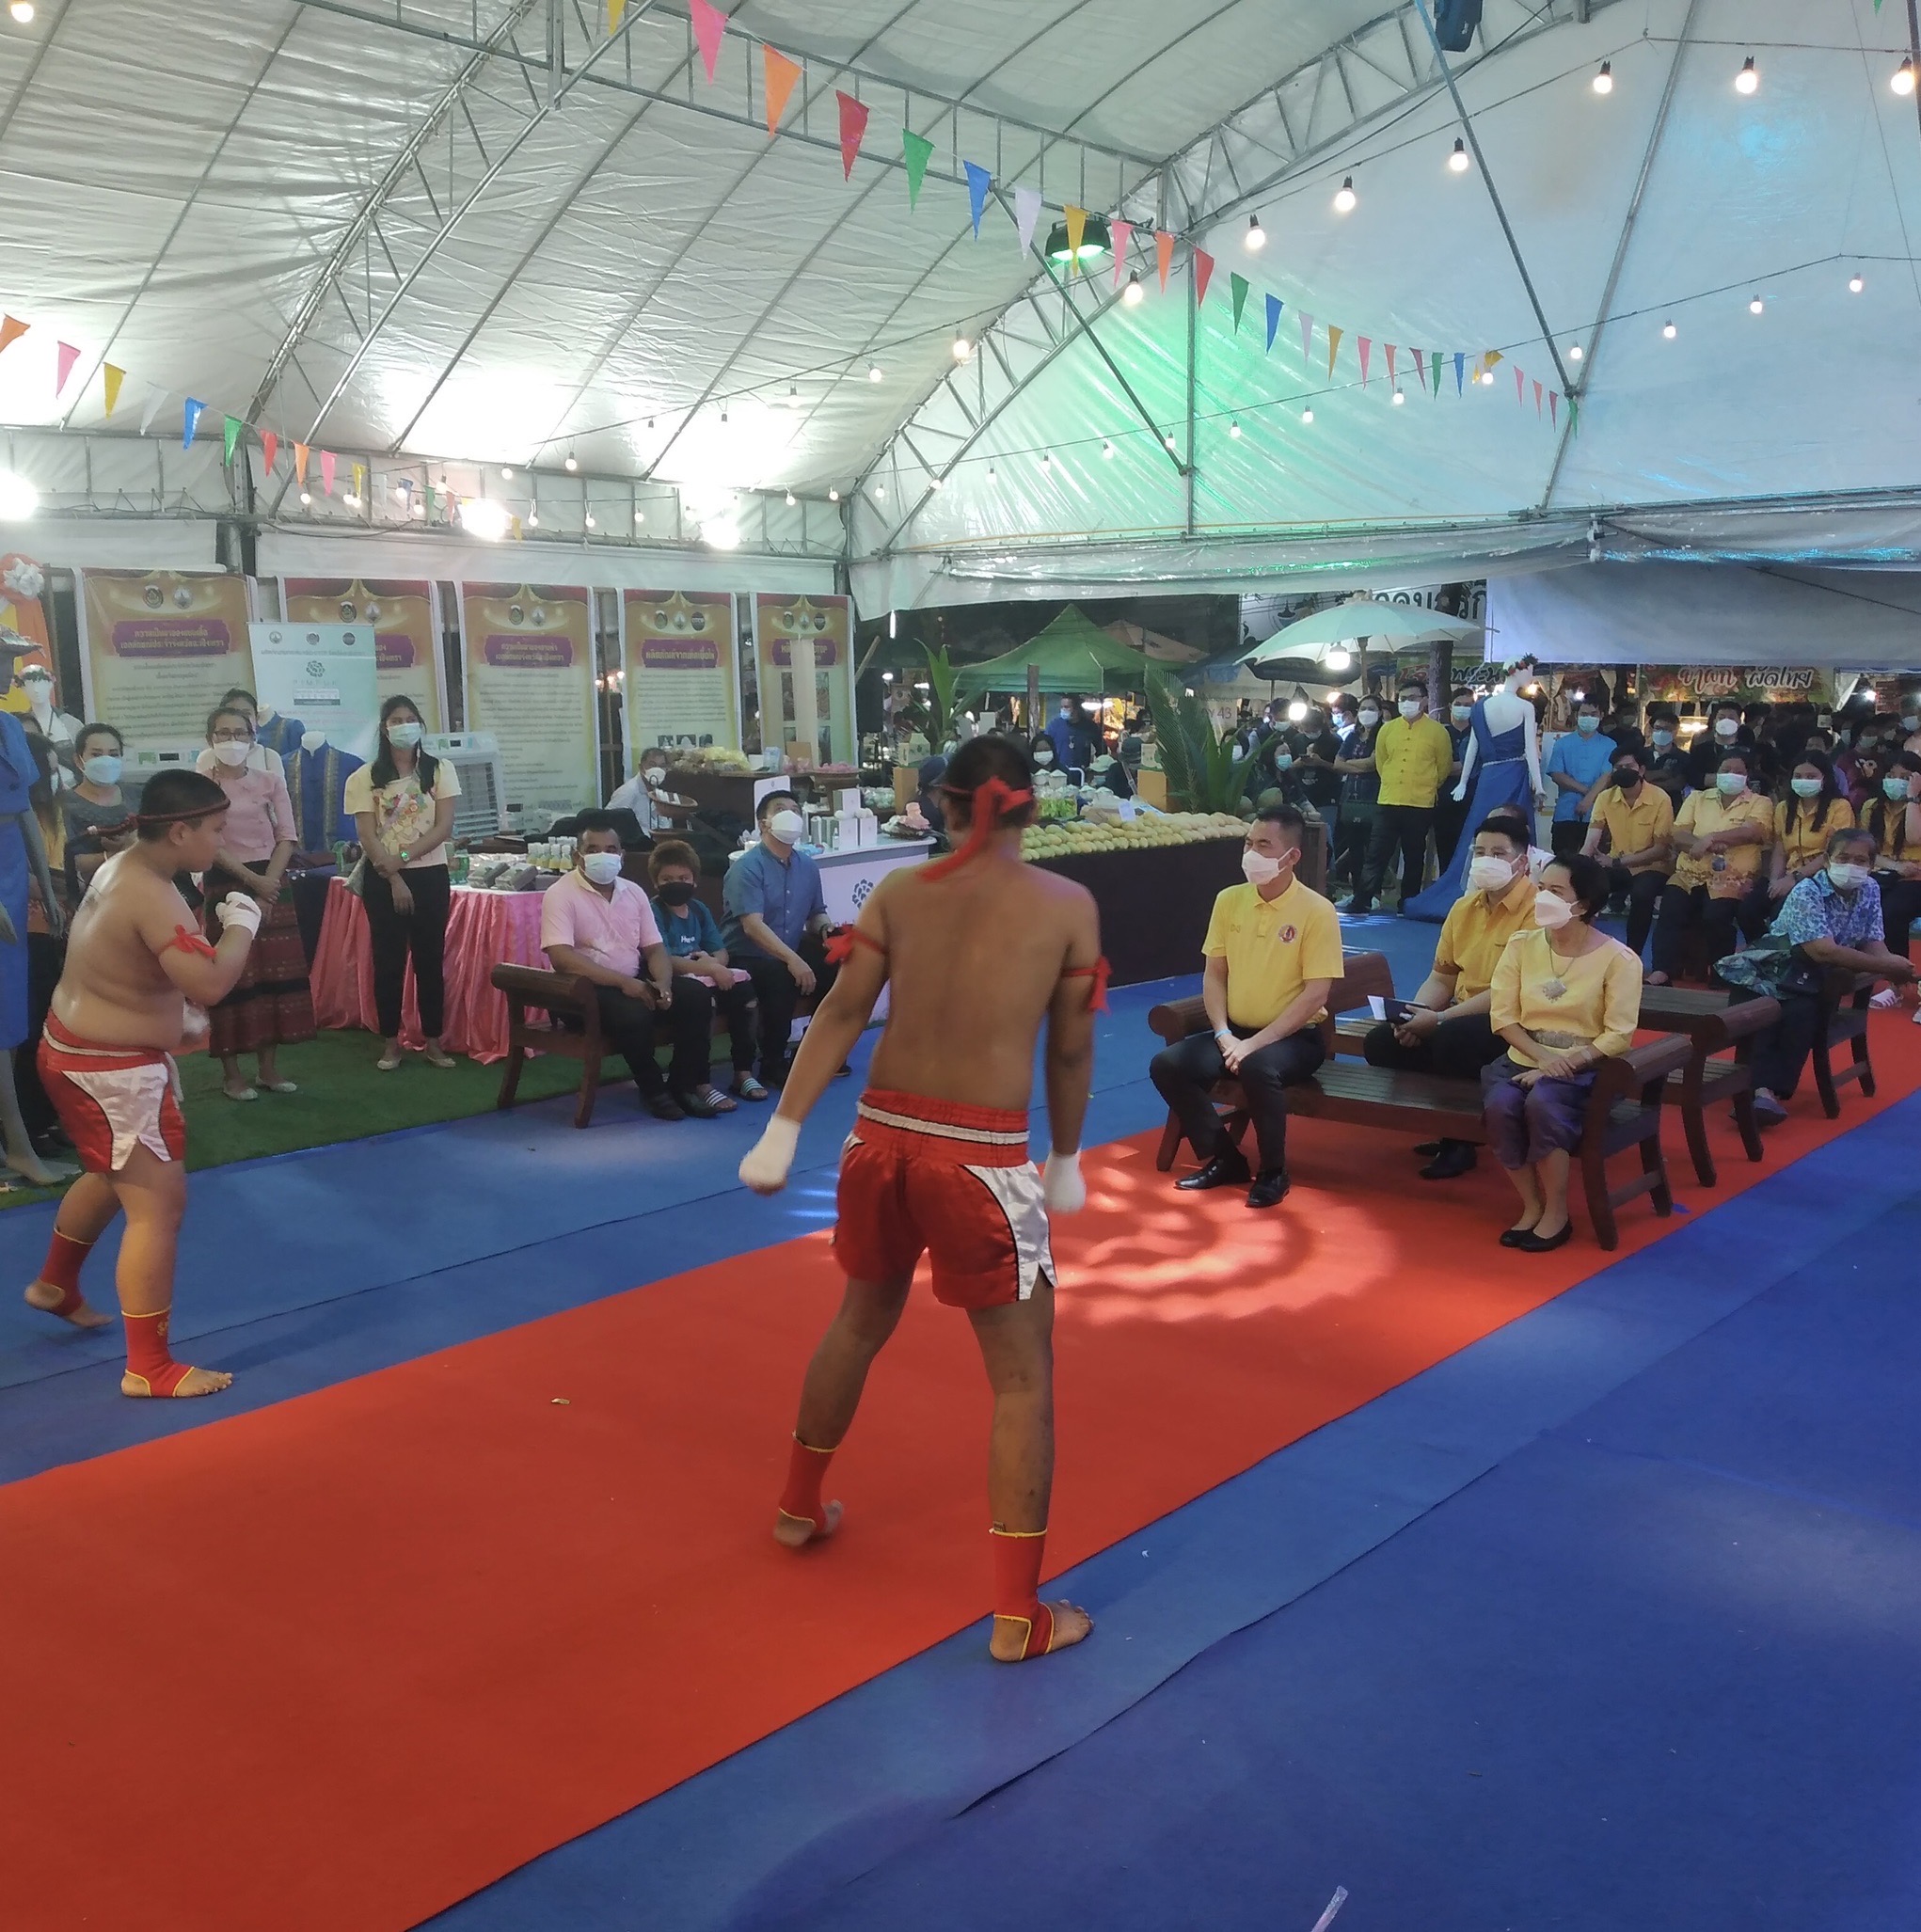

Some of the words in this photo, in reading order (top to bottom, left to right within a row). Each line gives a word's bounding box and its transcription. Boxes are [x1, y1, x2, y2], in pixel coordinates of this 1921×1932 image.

[1747, 666, 1814, 689] ผัดไทย
[1217, 706, 1232, 720] 43
